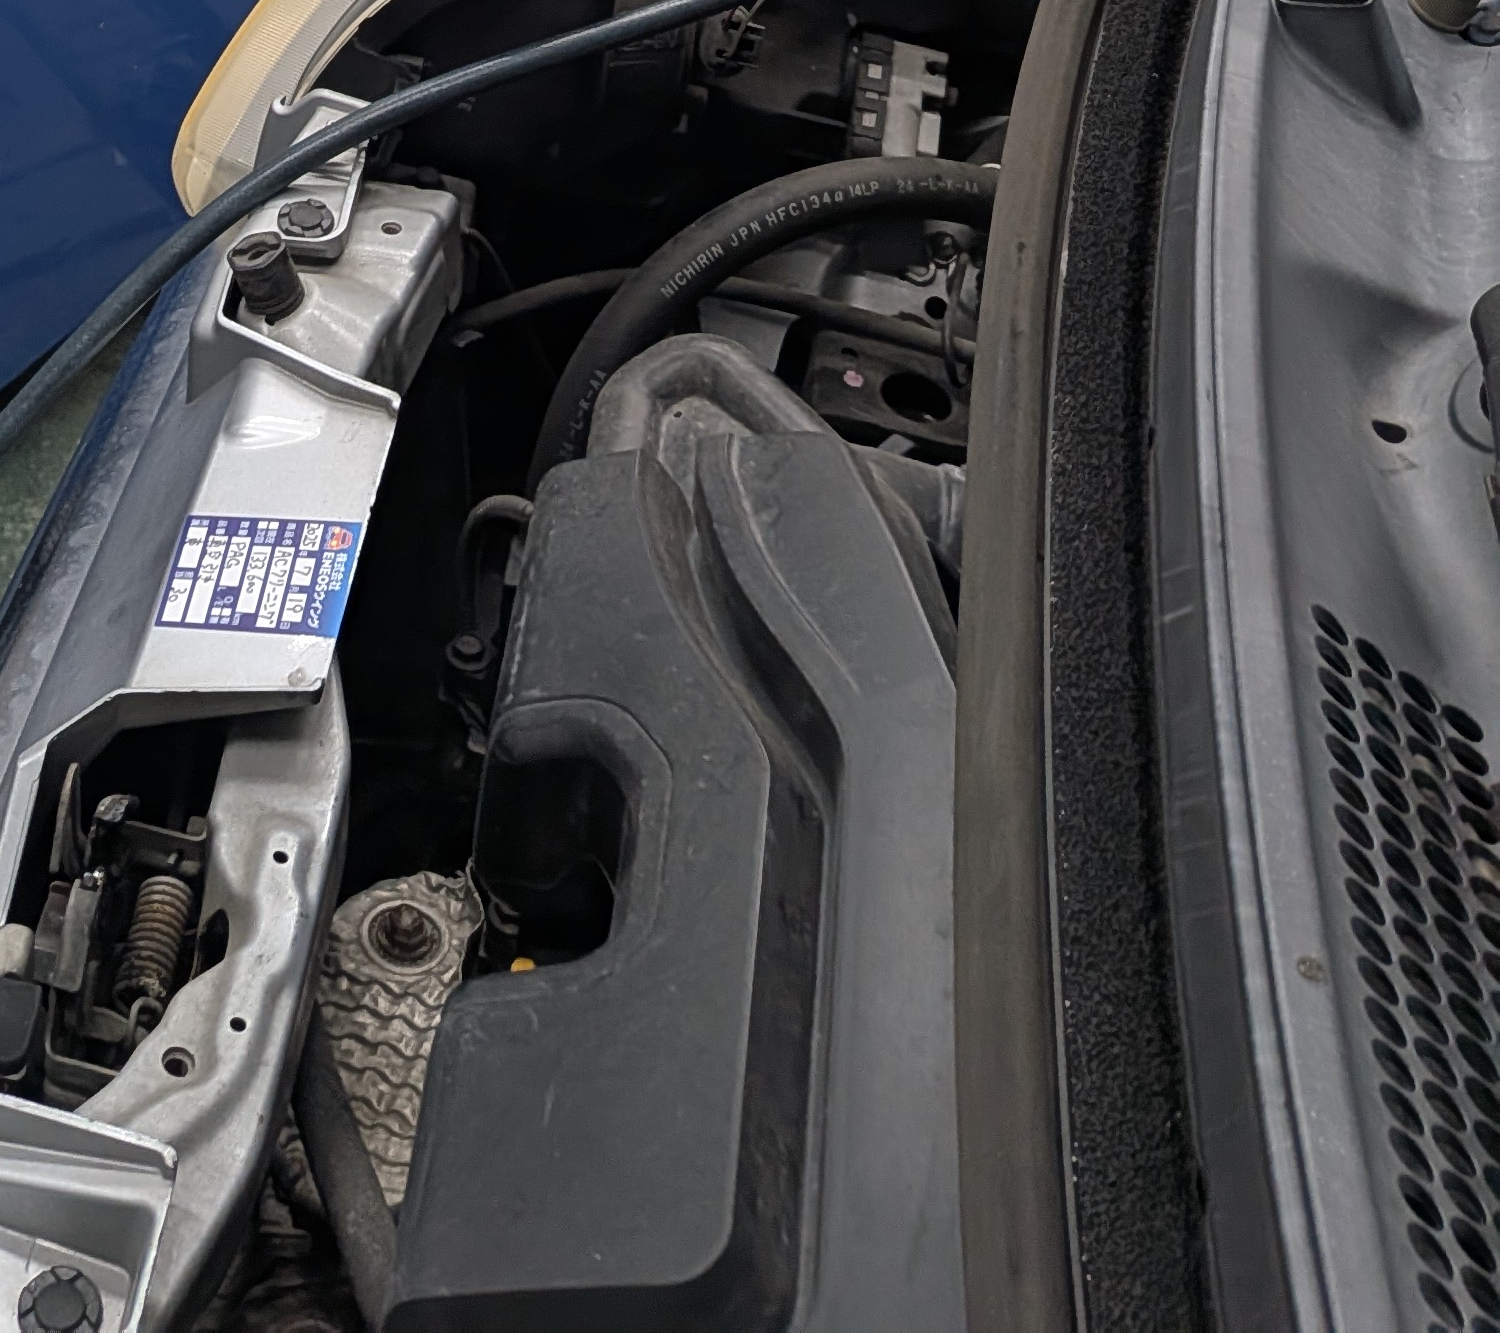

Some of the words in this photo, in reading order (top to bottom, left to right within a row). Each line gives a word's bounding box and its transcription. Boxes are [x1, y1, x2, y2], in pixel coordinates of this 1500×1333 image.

[660, 242, 724, 299] NICHIRIN
[730, 220, 762, 248] JPN
[764, 189, 845, 228] HFC134a
[848, 180, 881, 199] 14LP
[281, 522, 296, 545] 商品名
[300, 523, 321, 548] 2025
[224, 541, 246, 569] PAG
[293, 565, 311, 576] 7
[327, 552, 348, 591] 株式会社
[167, 586, 187, 602] 30
[256, 549, 292, 625] ACクリーニング
[305, 551, 335, 628] ENEOSウイング
[284, 598, 304, 613] 19
[231, 612, 241, 625] km
